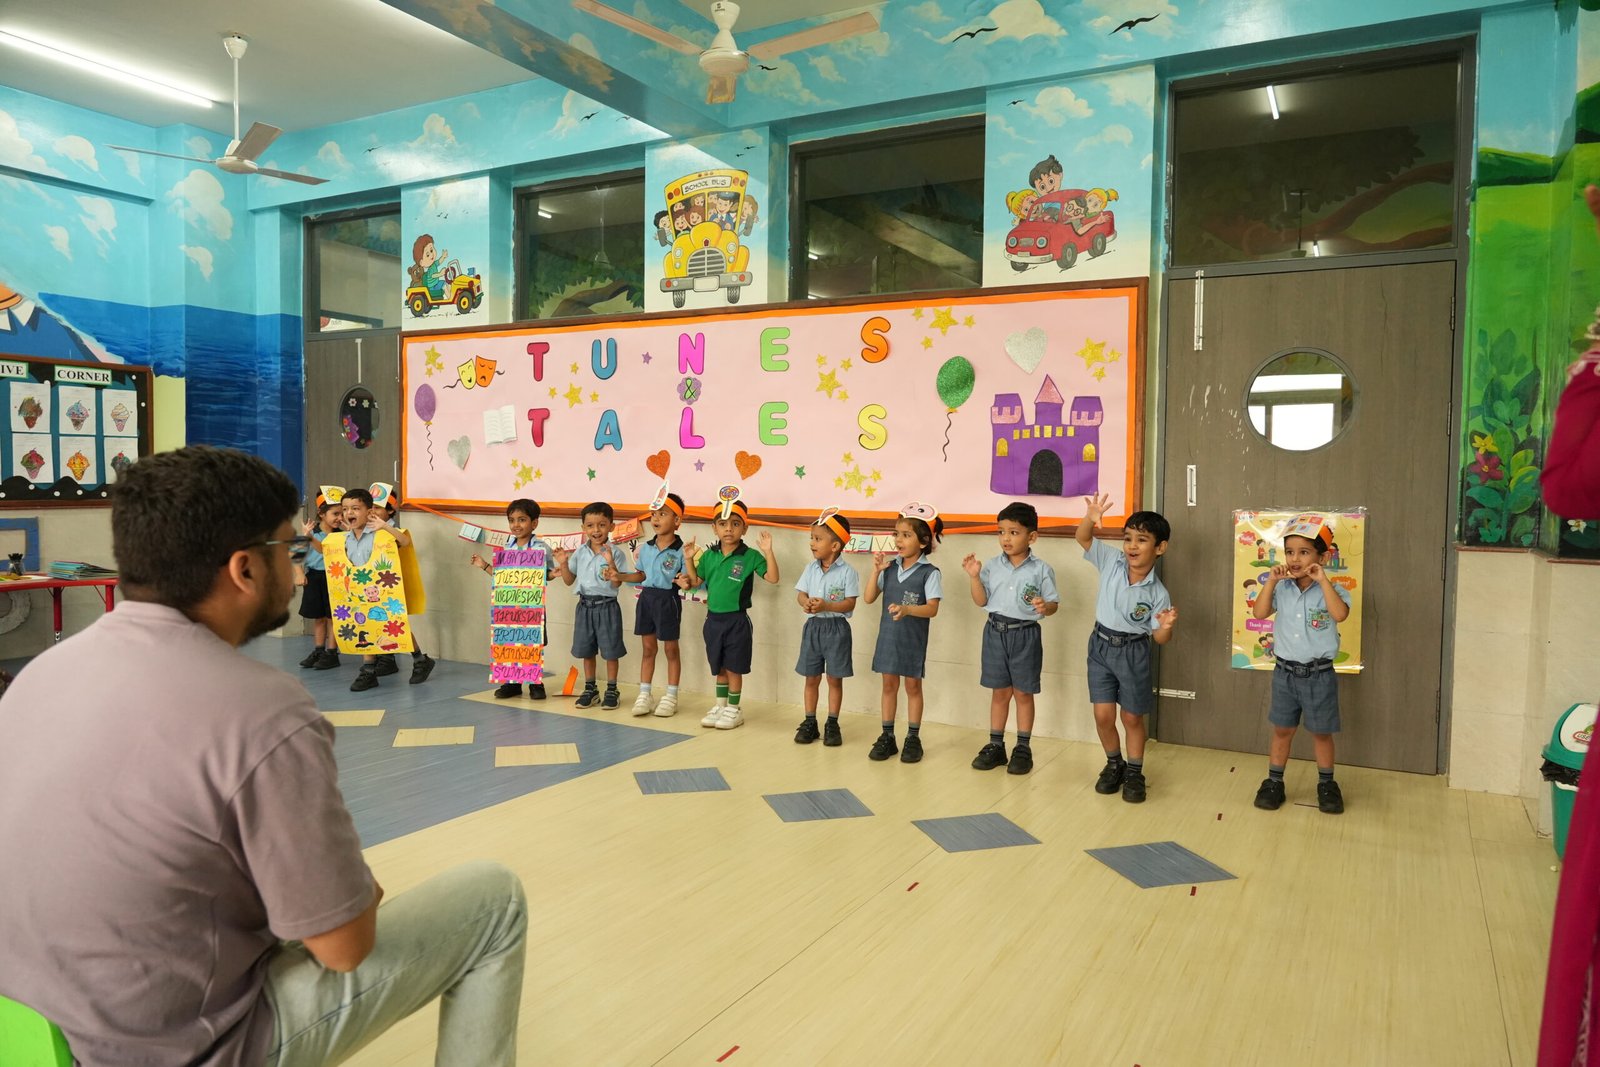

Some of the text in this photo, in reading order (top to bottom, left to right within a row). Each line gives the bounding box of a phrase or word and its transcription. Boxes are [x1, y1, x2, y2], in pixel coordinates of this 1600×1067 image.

[684, 178, 727, 192] SCHOOL BUS
[57, 369, 110, 382] CORNER
[496, 551, 544, 566] MONDAY
[496, 569, 544, 586] TUESDAY
[495, 589, 542, 605] WEDNESDAY
[494, 610, 542, 624] THURSDAY
[494, 626, 540, 643] FRIDAY
[493, 647, 542, 662] SATURDAY
[494, 666, 541, 680] SUNDAY
